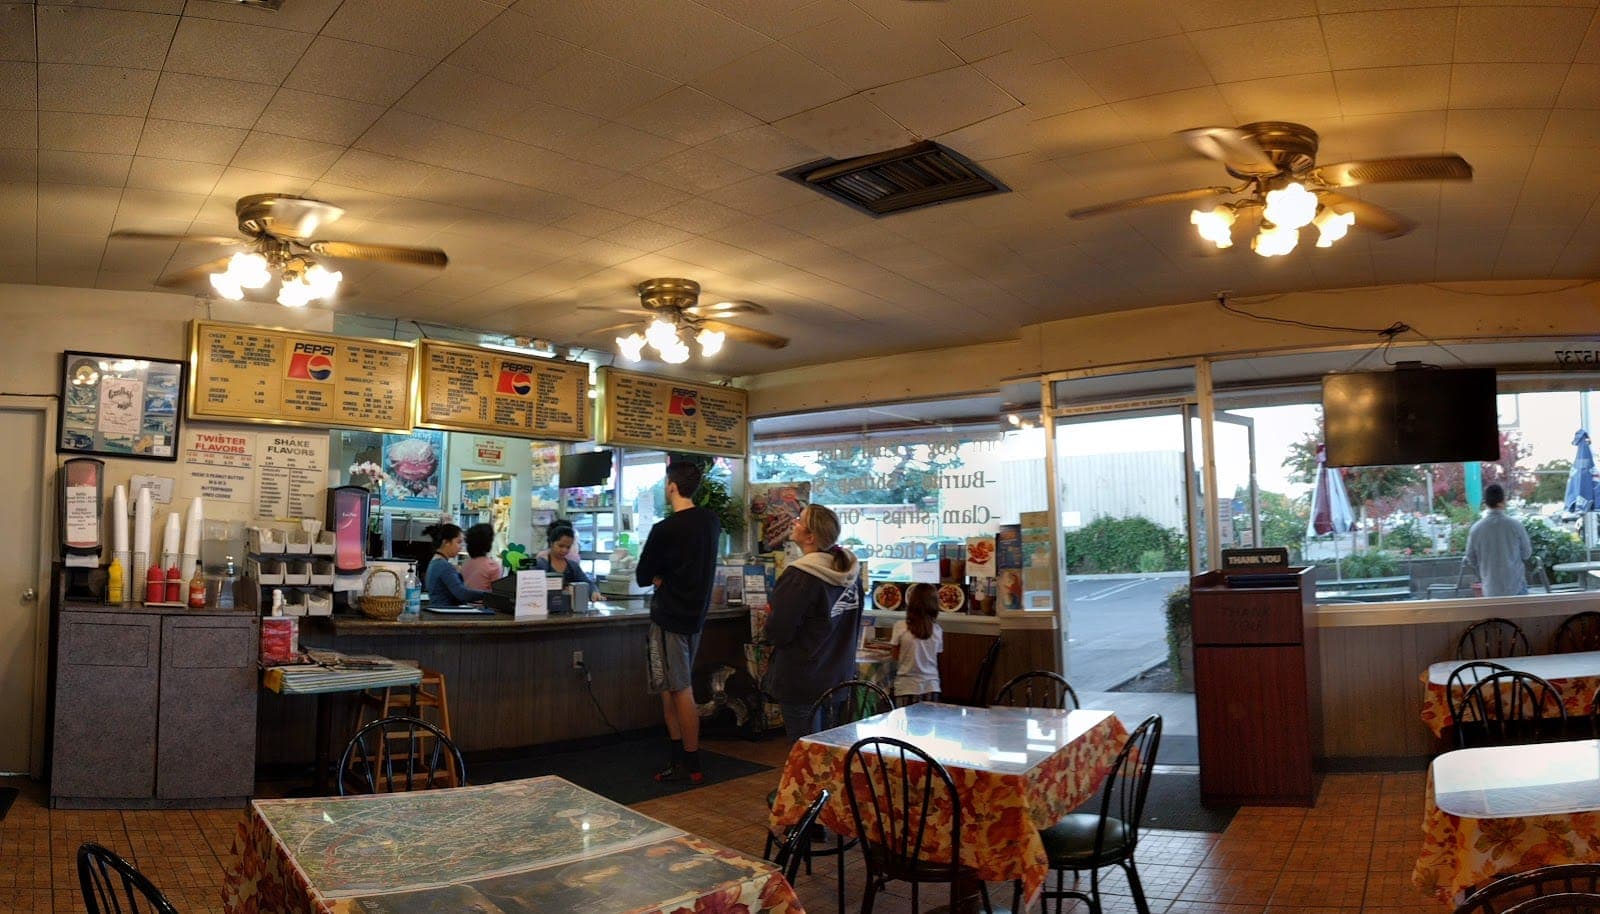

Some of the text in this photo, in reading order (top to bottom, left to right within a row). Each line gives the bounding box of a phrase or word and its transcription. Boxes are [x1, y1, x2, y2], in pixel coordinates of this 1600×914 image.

[293, 342, 335, 356] PEPSI
[501, 361, 533, 374] PEPSI
[672, 387, 698, 398] PEPSI
[196, 433, 246, 446] TWISTER
[274, 438, 311, 448] SHAKE
[195, 442, 245, 453] FLAVORS
[267, 445, 315, 456] FLAVORS
[1228, 554, 1281, 565] THANK YOU
